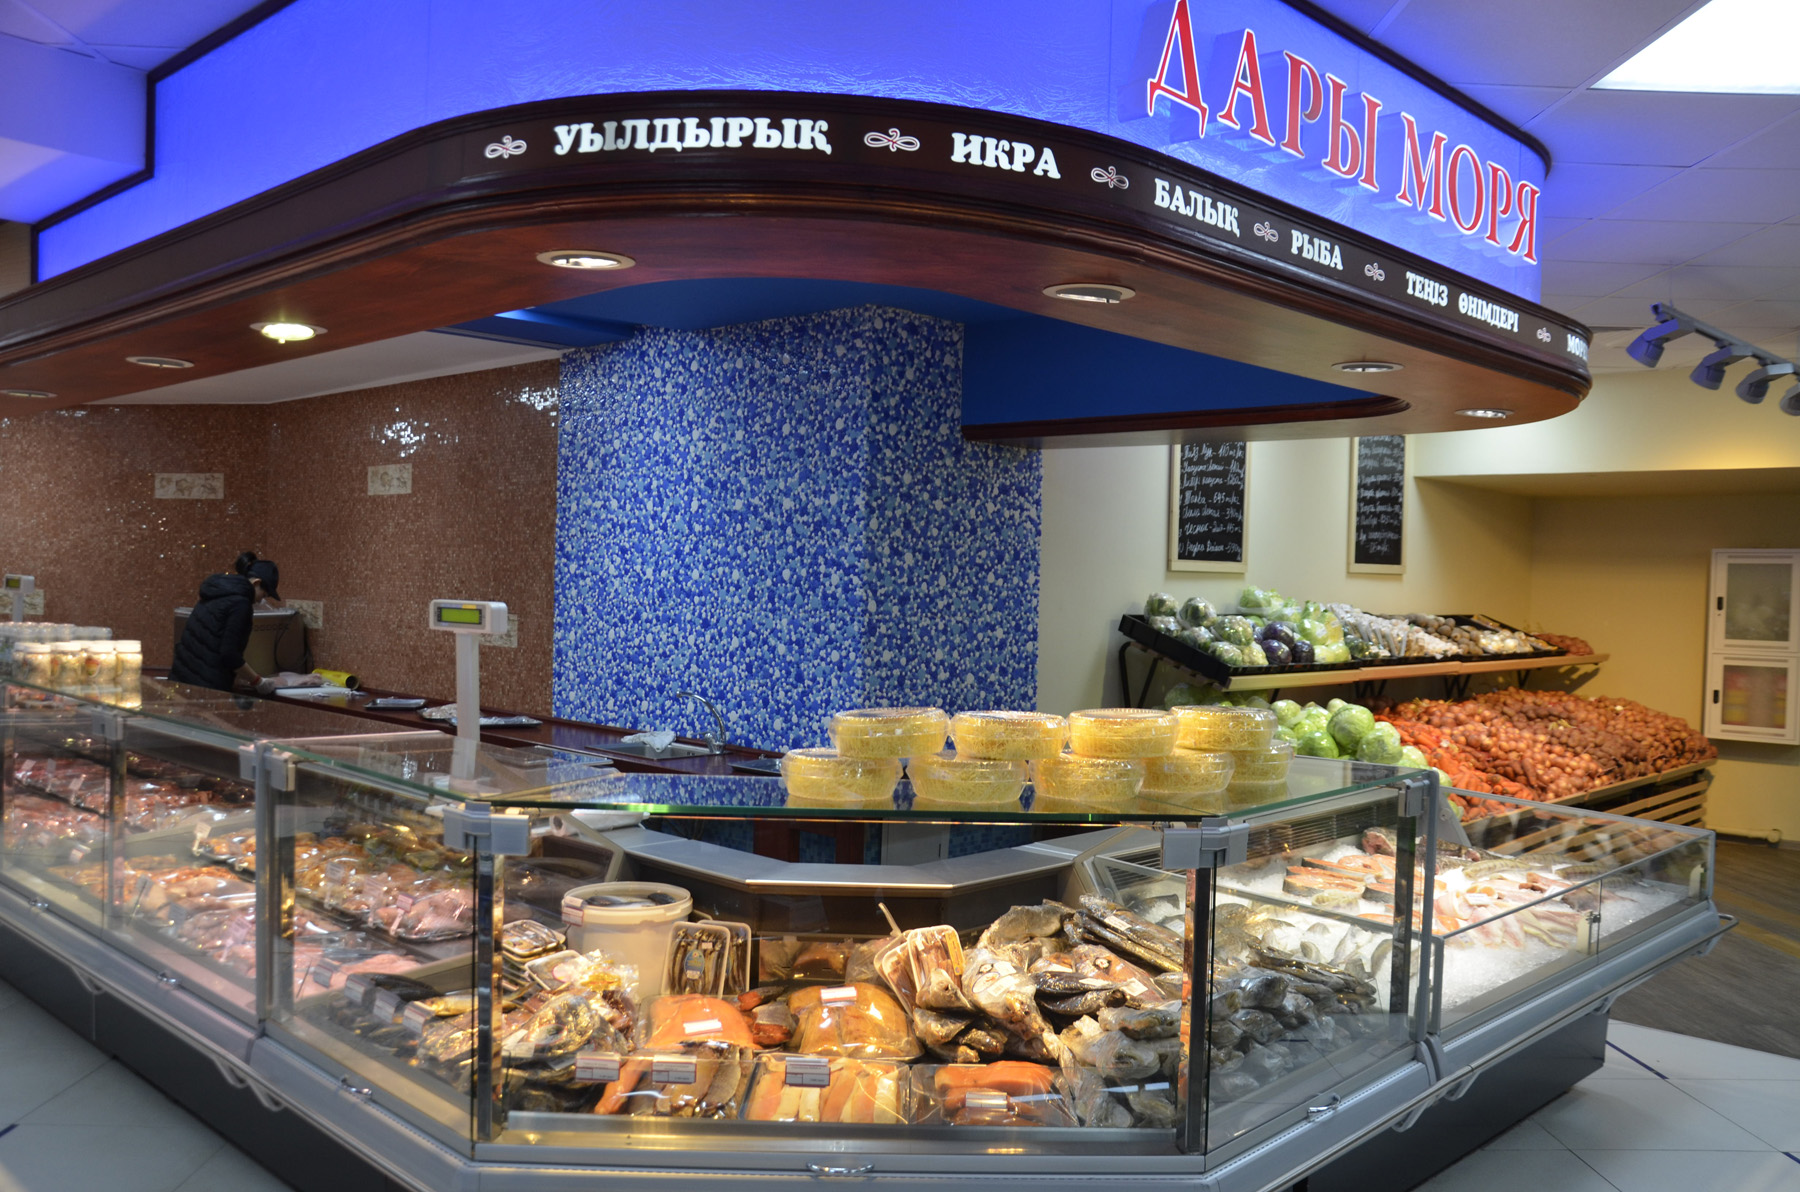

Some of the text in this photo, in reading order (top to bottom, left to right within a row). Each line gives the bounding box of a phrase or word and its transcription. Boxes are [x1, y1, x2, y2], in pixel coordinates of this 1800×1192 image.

[552, 116, 832, 155] УЫЛДЫРЫҚ
[950, 132, 1062, 179] ИКРА
[1147, 0, 1541, 264] ДАРЫ МОРЯ
[1153, 177, 1241, 238] БАЛЫҚ
[1290, 229, 1344, 271] РЫБА
[1405, 270, 1520, 333] ТЕҢІЗ ӨНІМДЕРІ
